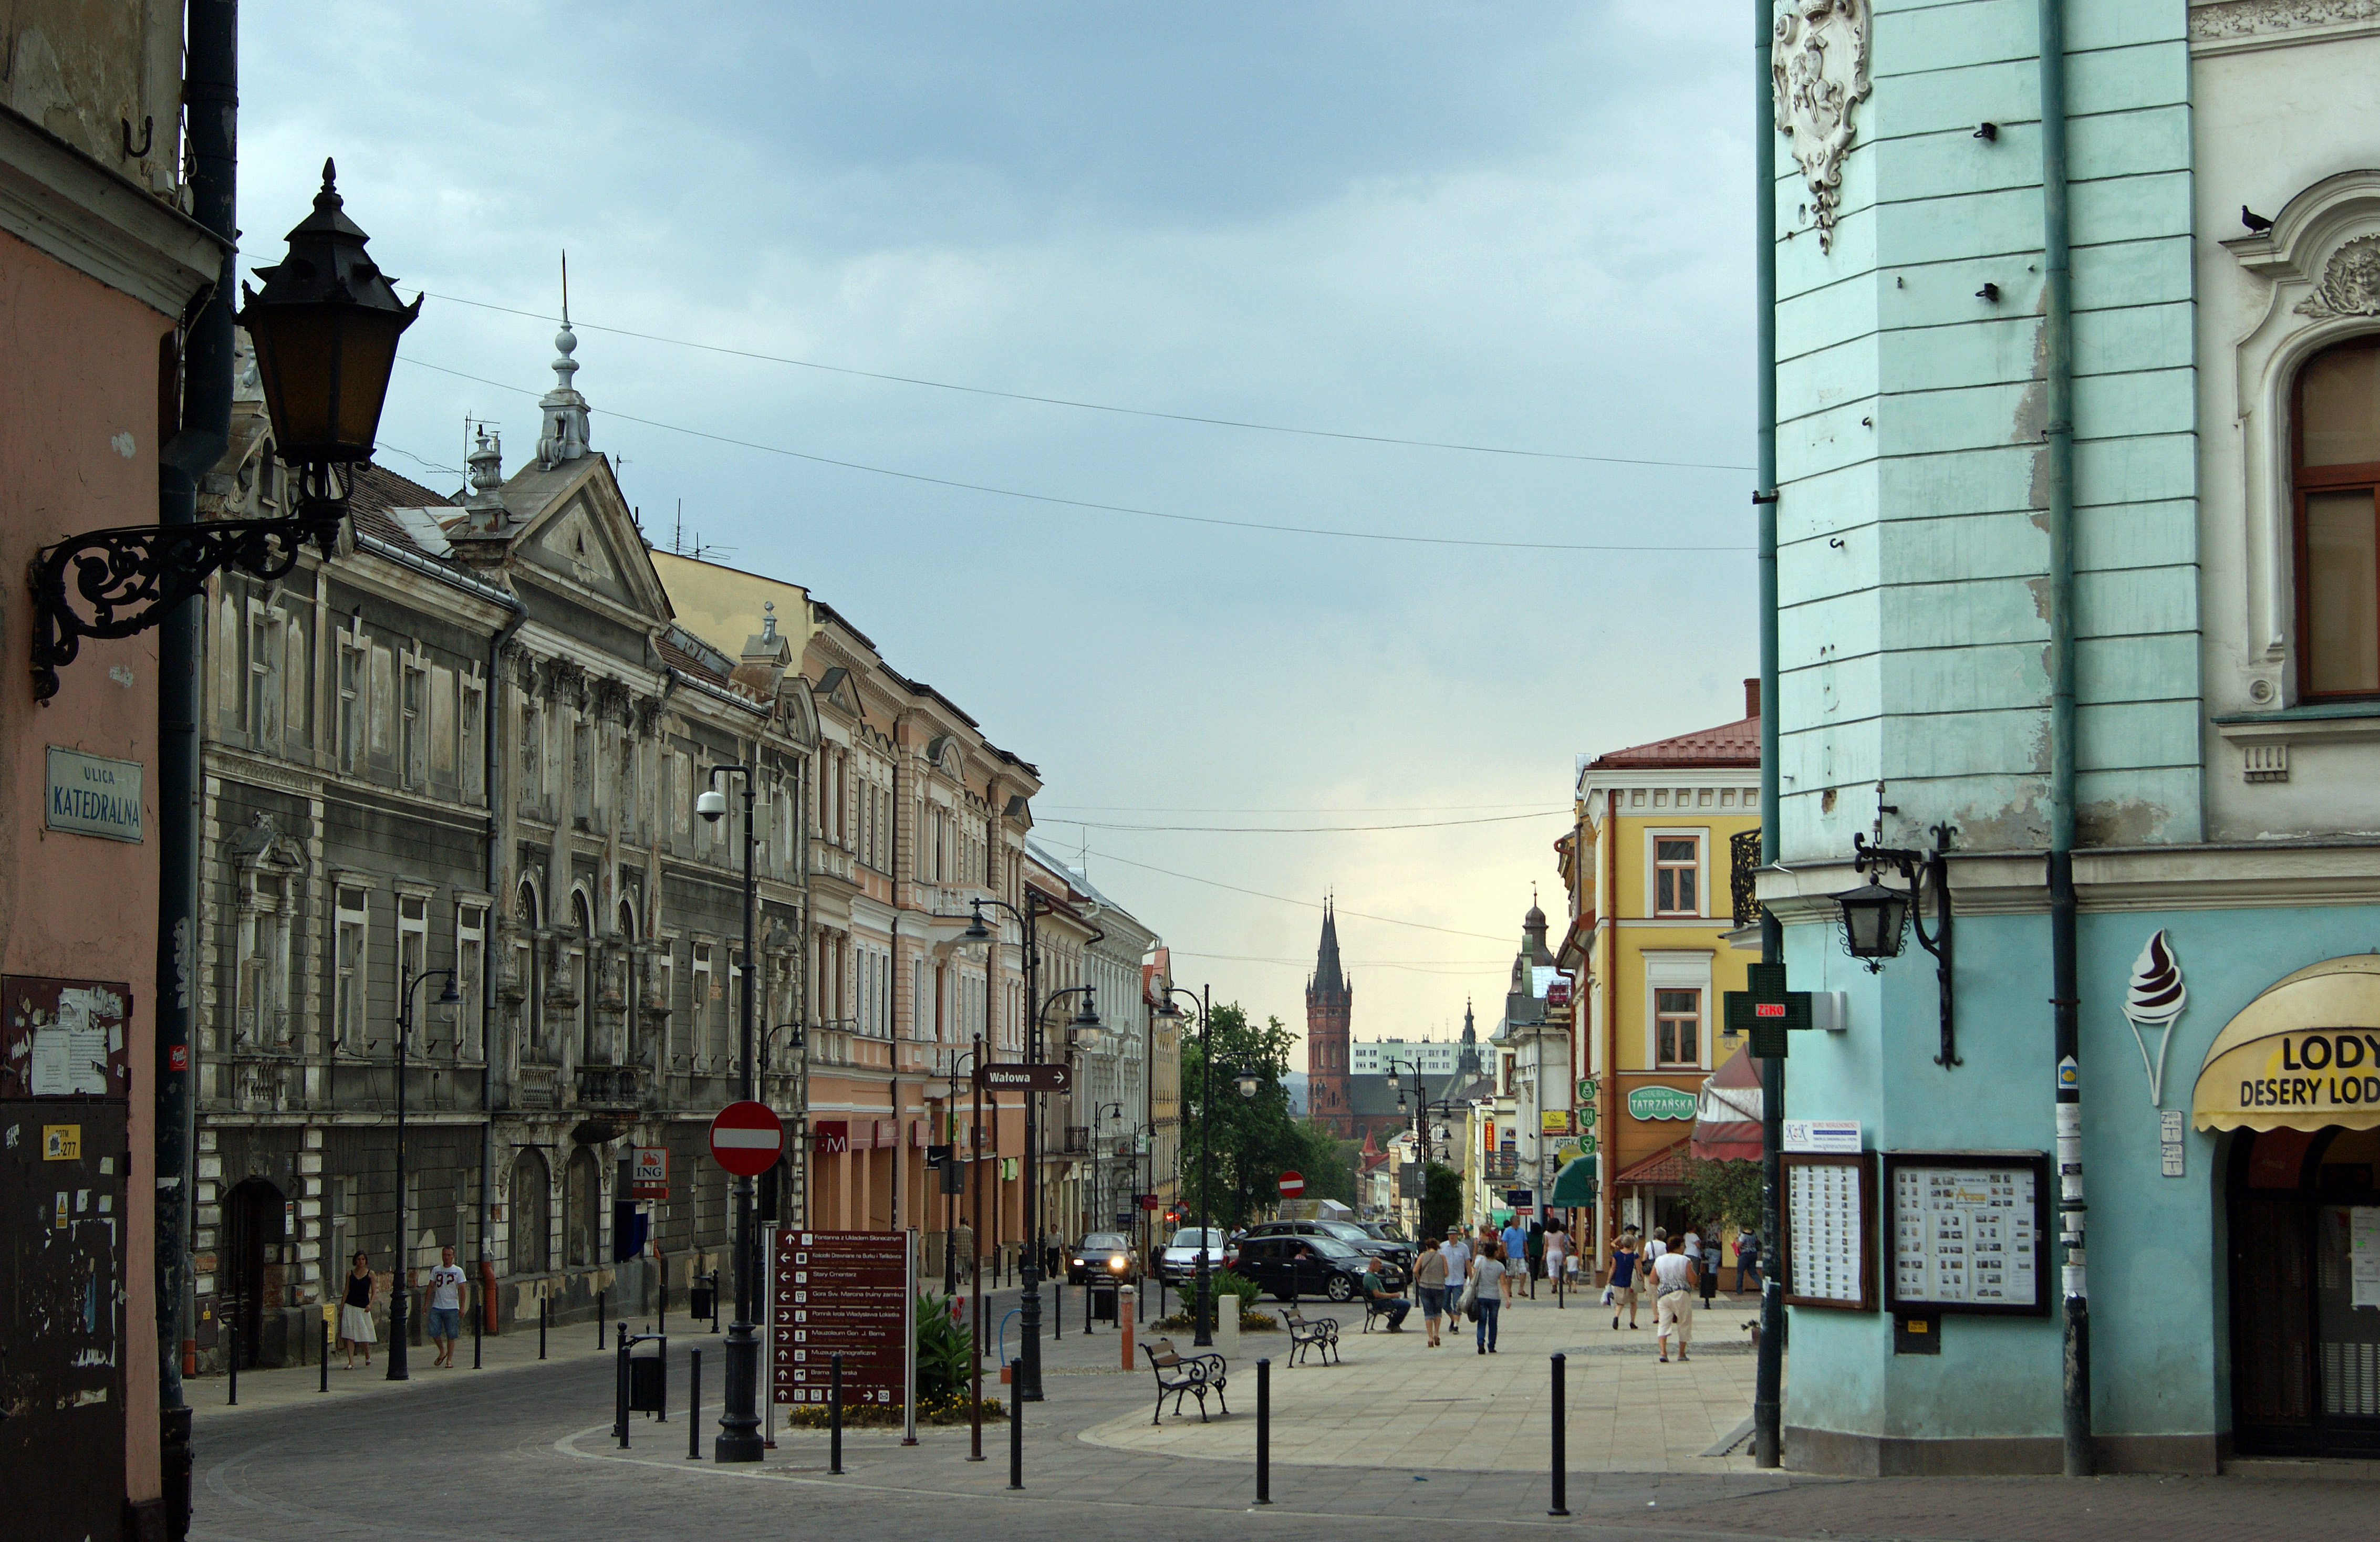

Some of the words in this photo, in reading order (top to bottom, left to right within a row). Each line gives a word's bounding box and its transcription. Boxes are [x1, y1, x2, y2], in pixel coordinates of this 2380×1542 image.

[84, 767, 114, 785] ULICA
[54, 786, 139, 828] KATEDRALNA
[989, 1071, 1031, 1083] Wałowa
[2240, 1078, 2322, 1107] DESERY
[1631, 1098, 1693, 1111] TATRZAŃSKA
[637, 1166, 662, 1178] ING
